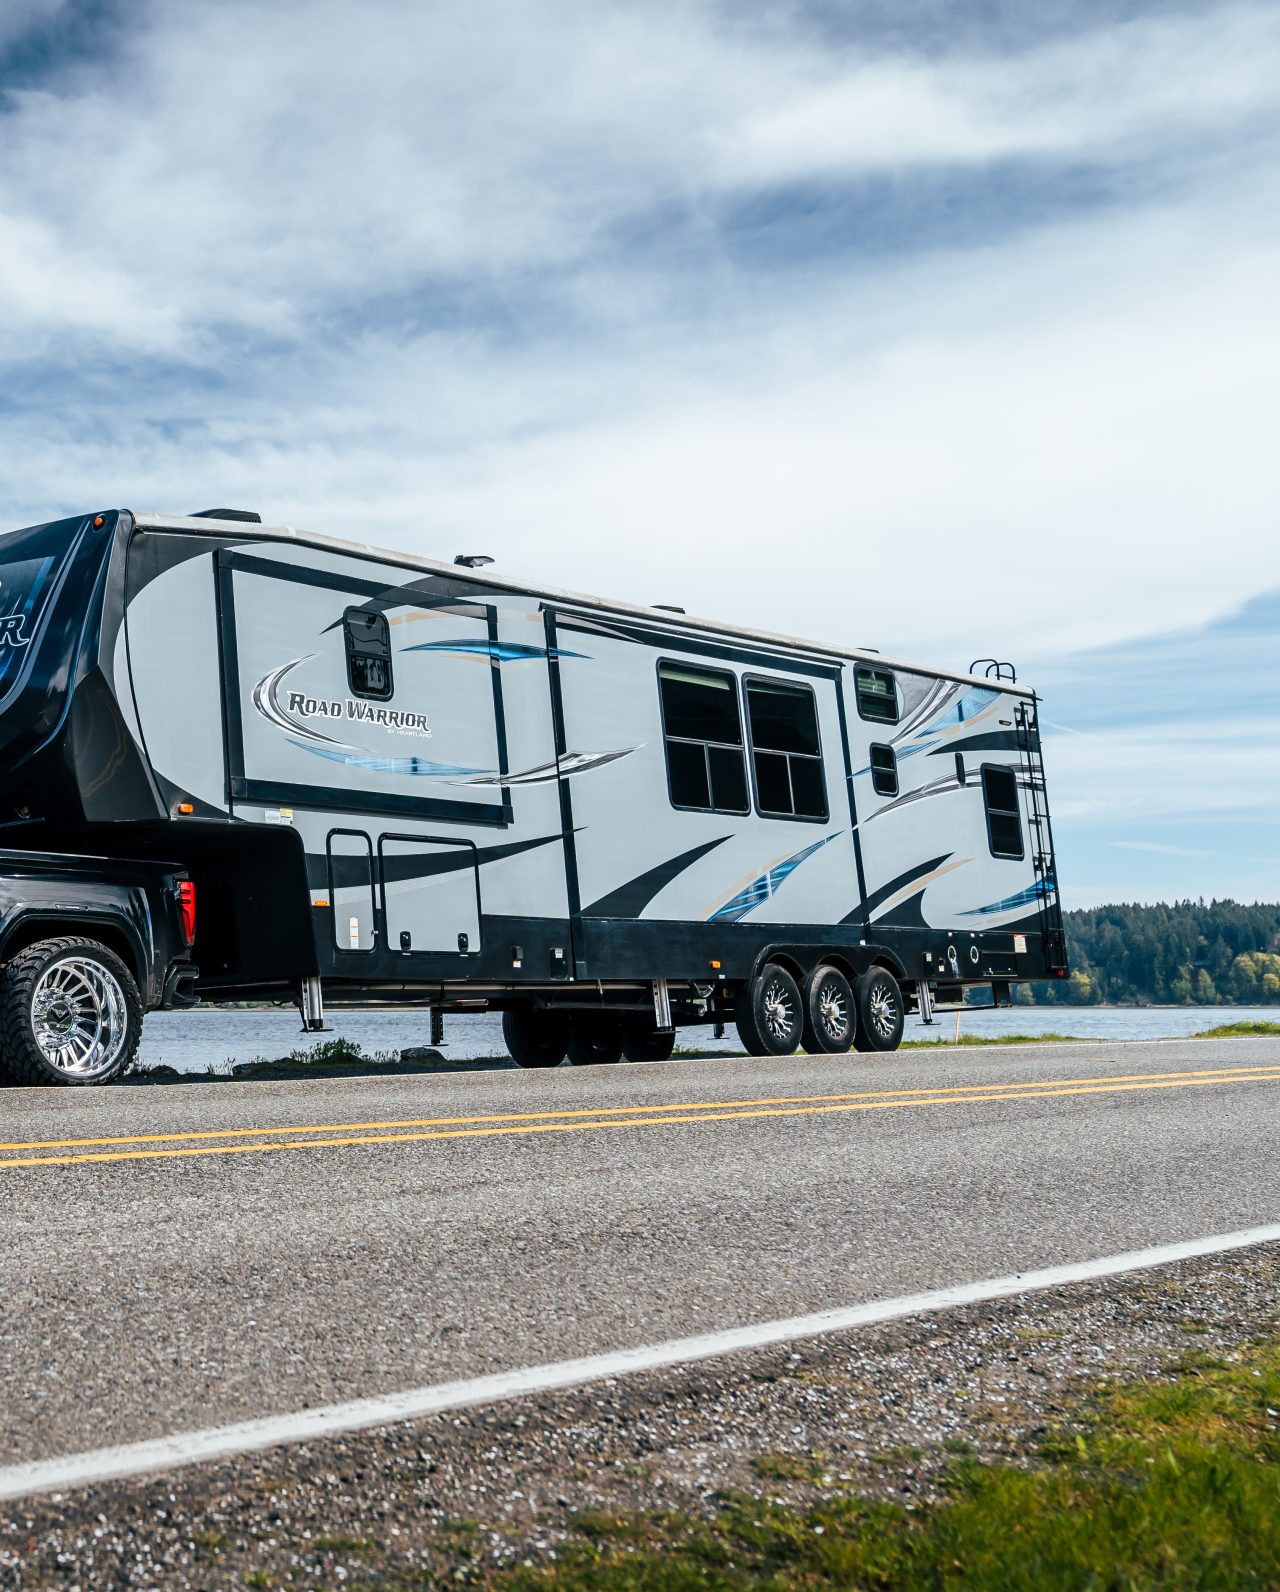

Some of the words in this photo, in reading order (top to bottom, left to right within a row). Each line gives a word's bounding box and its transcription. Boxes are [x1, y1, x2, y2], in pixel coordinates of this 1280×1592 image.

[287, 691, 342, 718] ROAD
[346, 699, 431, 732] WARRIOR
[397, 729, 433, 739] HEARTLAND
